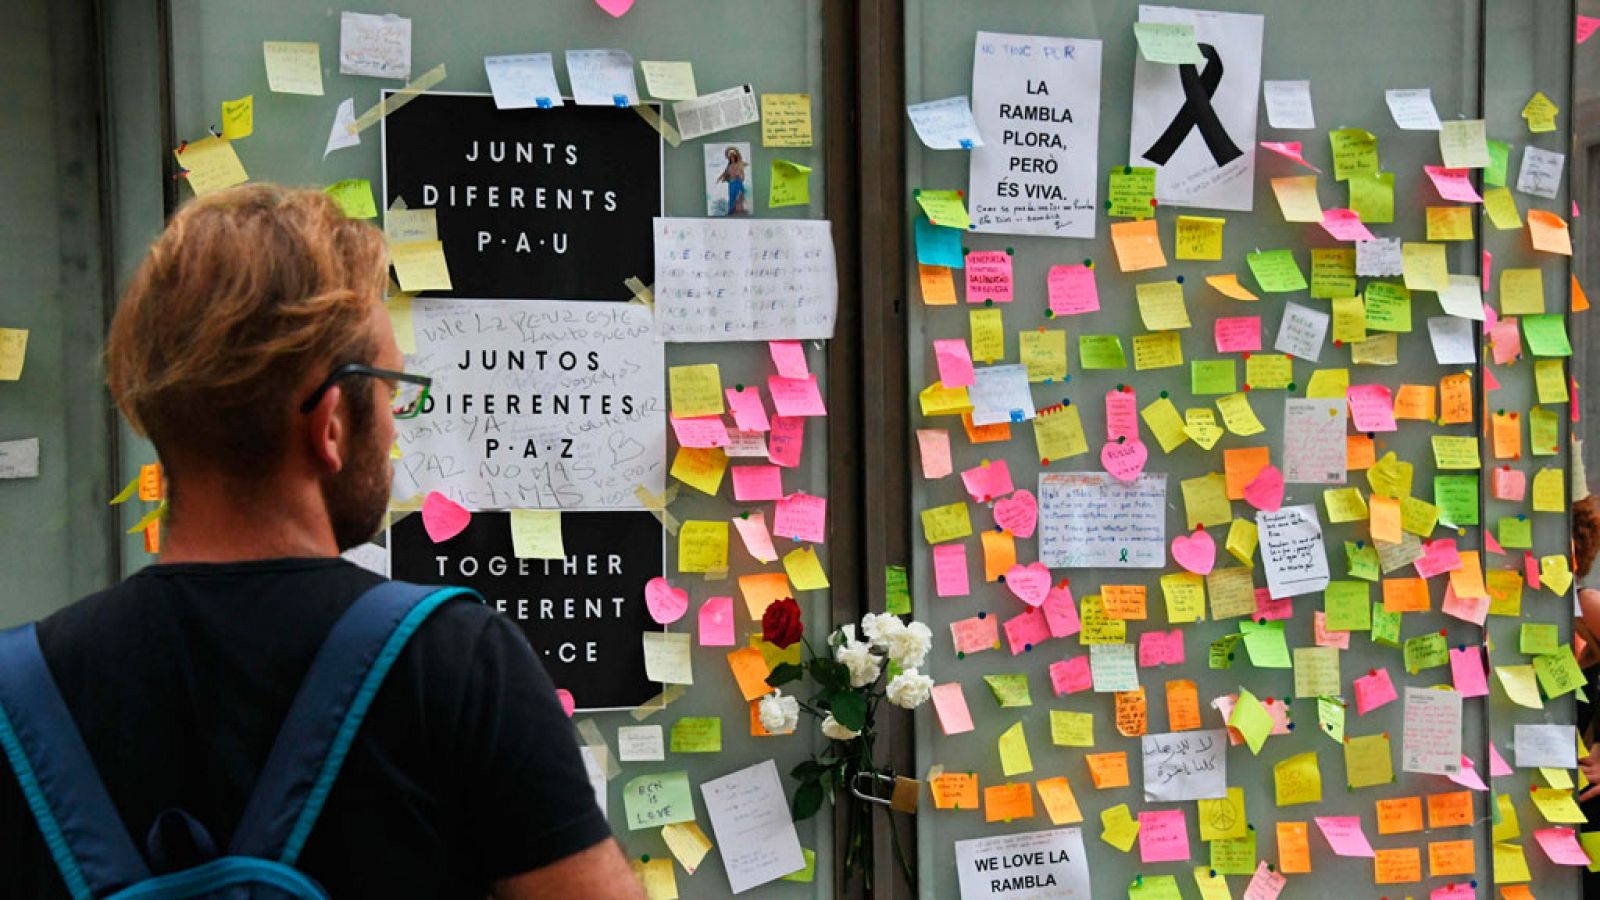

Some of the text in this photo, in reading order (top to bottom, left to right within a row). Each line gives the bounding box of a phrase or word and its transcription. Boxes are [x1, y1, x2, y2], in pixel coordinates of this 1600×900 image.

[1027, 80, 1049, 95] LA
[1000, 103, 1073, 123] RAMBLA
[1003, 130, 1067, 151] PLORA,
[465, 141, 579, 165] JUNTS
[1010, 154, 1059, 174] PERÒ
[423, 185, 618, 211] DIFERENTS
[997, 177, 1067, 201] ÉS VIVA.
[458, 350, 599, 371] JUNTOS
[421, 395, 634, 415] DIFERENTES
[486, 439, 573, 458] P·A·Z
[479, 461, 522, 480] NO
[436, 555, 623, 577] TOGETHER
[482, 598, 625, 619] FERENT
[975, 849, 1070, 872] WE LOVE LA
[990, 873, 1057, 893] RAMBLA
